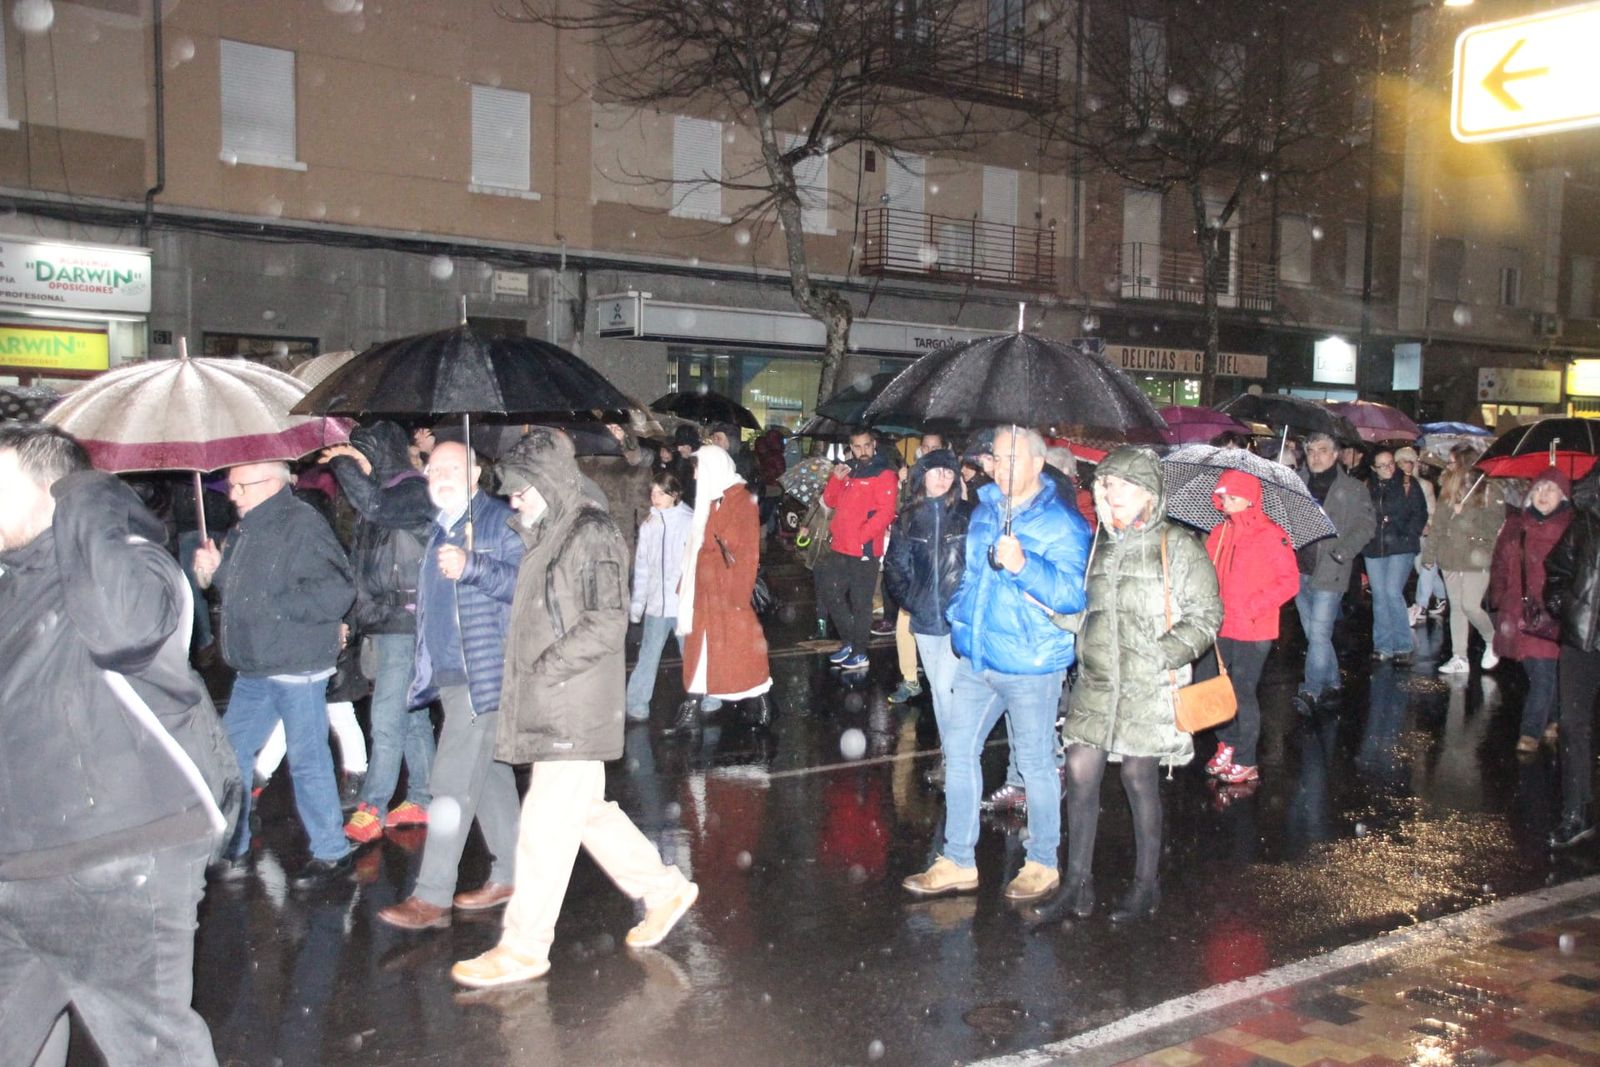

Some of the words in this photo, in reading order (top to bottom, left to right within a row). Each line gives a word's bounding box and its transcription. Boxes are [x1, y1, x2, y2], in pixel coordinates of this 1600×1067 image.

[49, 281, 114, 294] OPOSICIONES
[0, 290, 66, 302] PROFESIONAL
[1122, 348, 1176, 370] DELICIAS
[1194, 353, 1239, 375] GNEL
